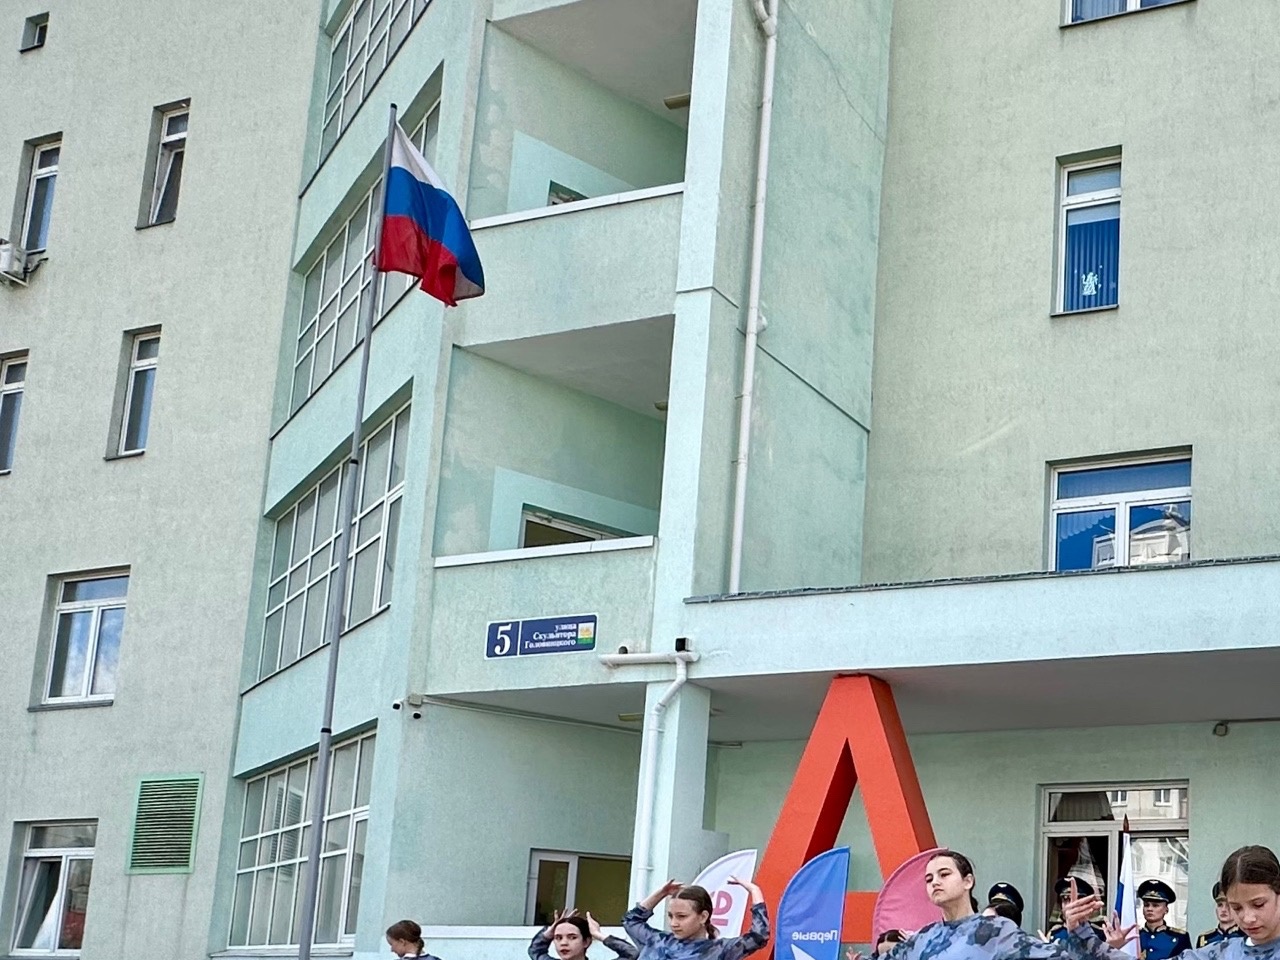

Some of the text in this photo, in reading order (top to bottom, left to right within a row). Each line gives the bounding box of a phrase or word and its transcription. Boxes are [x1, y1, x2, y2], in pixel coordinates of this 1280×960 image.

[554, 623, 577, 632] улица
[494, 623, 512, 655] 5
[533, 631, 577, 641] Скульптора
